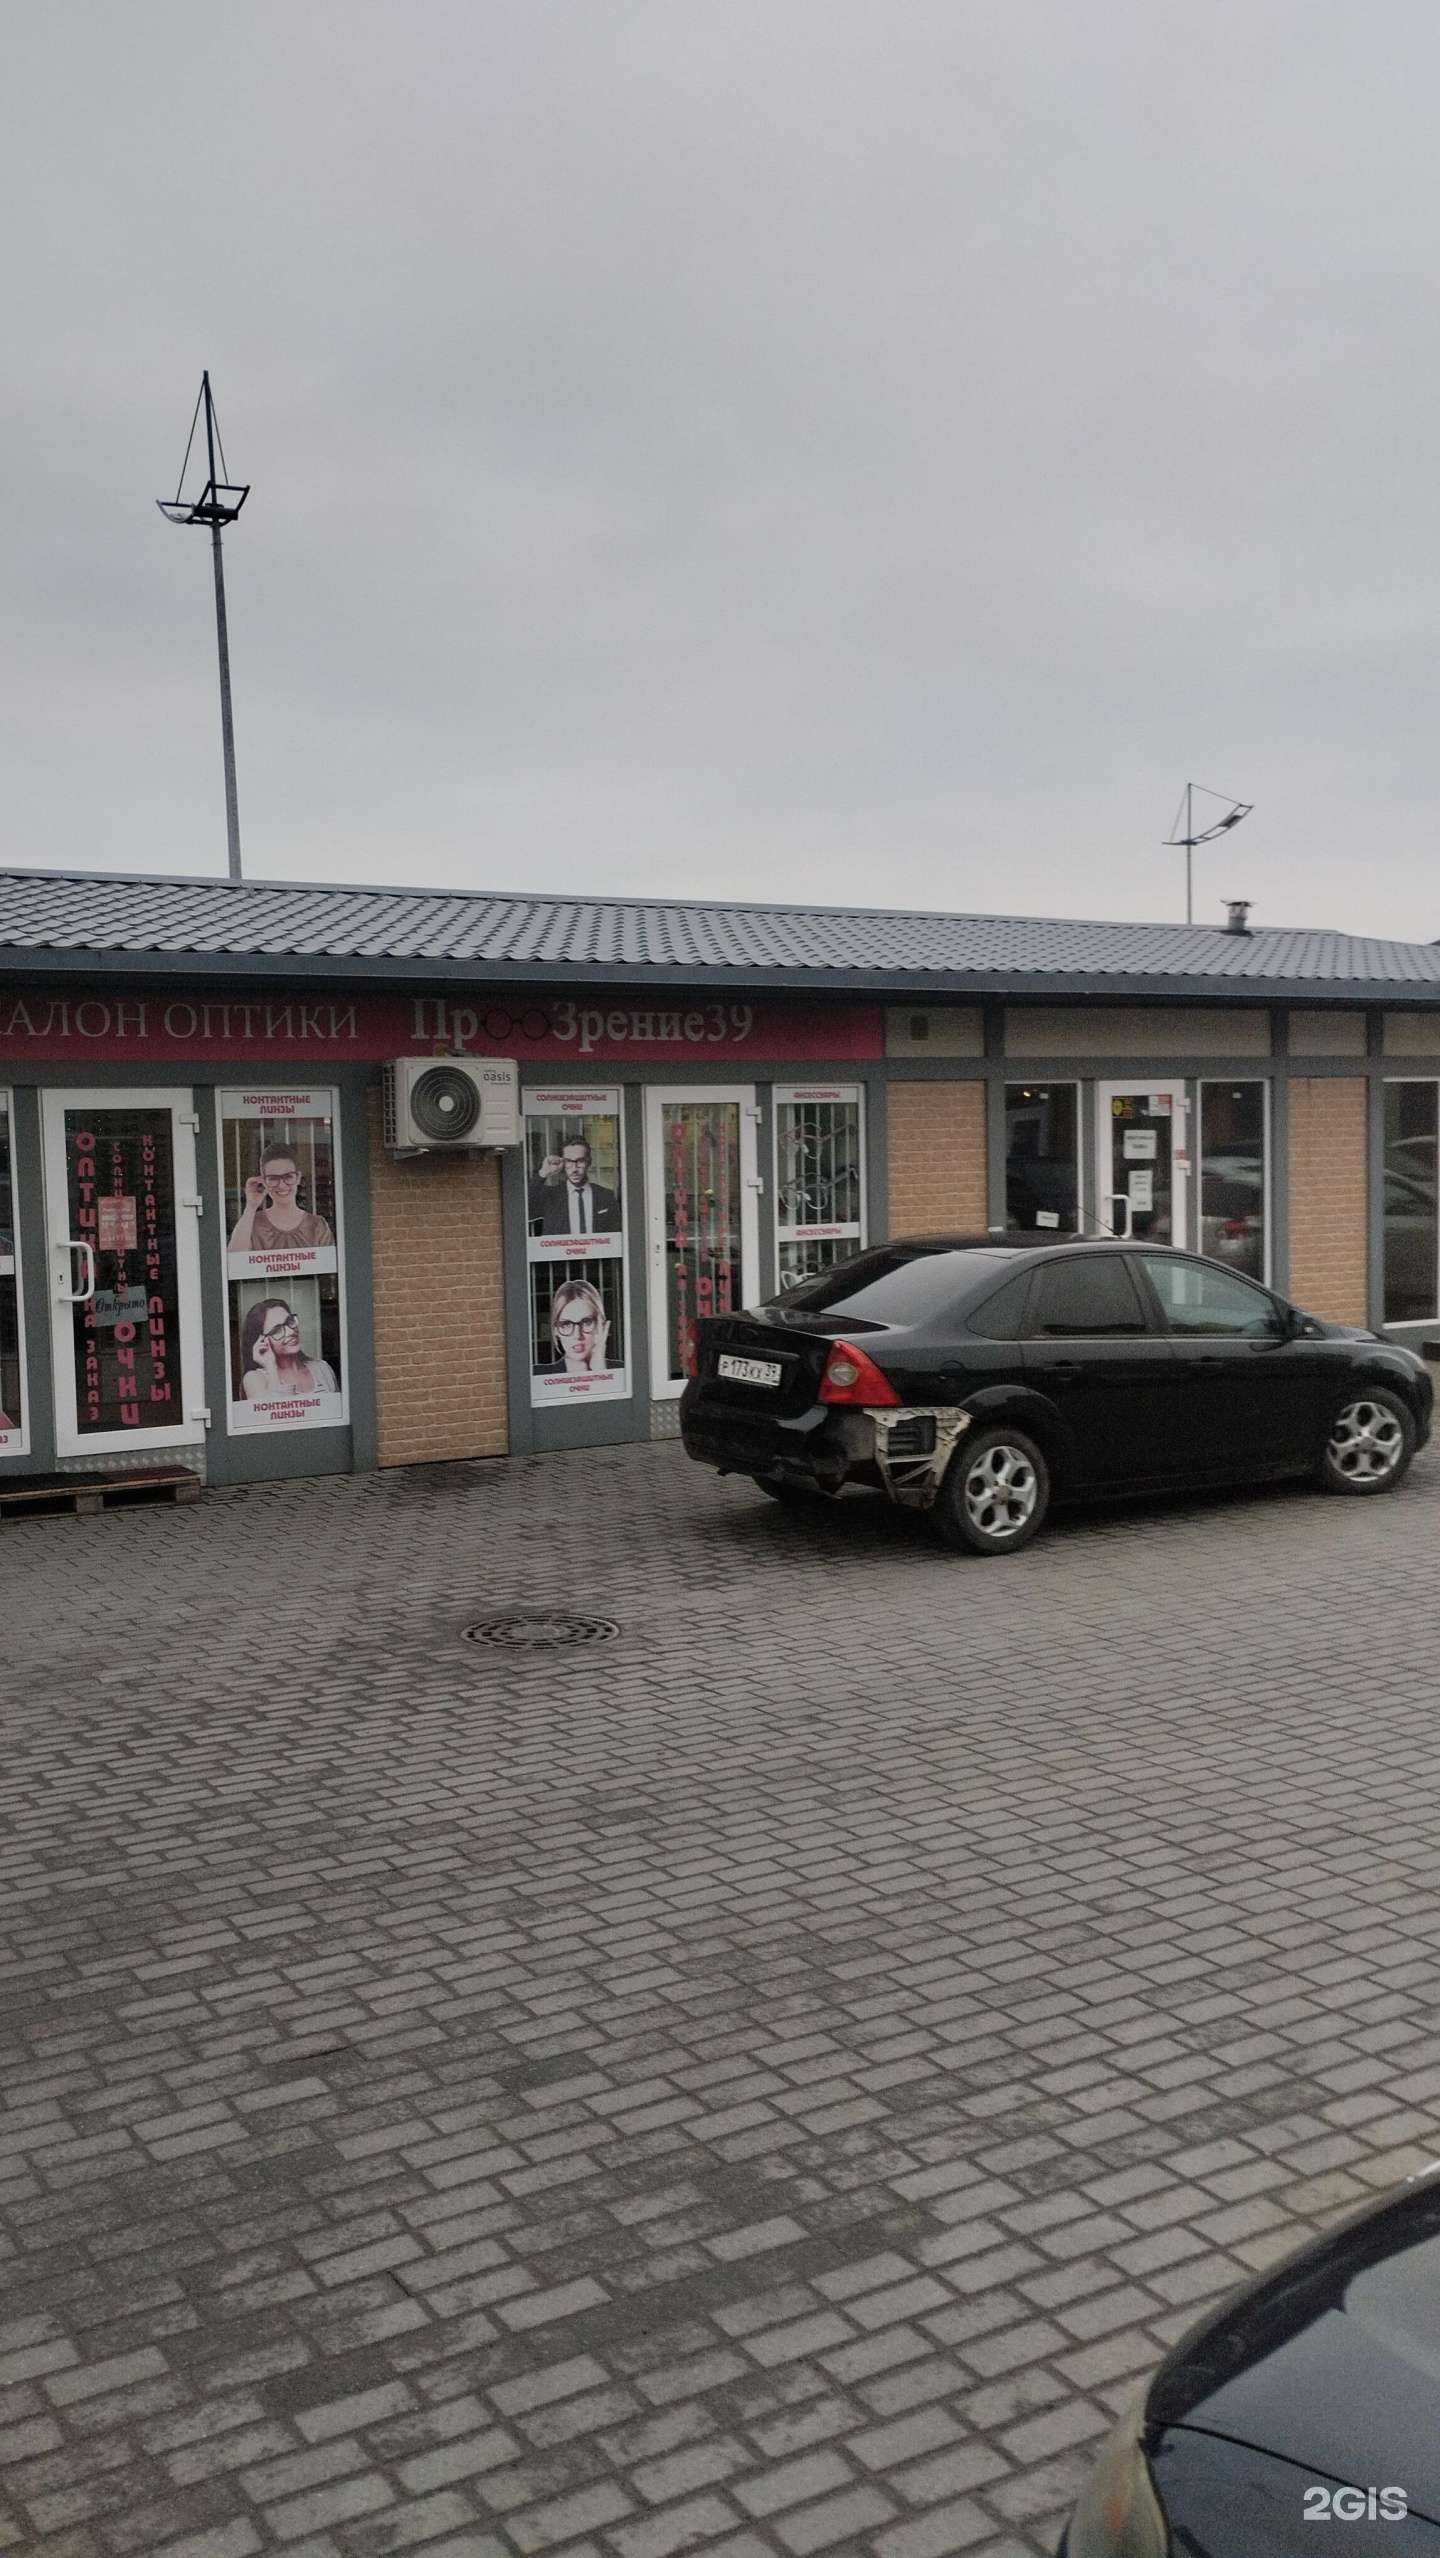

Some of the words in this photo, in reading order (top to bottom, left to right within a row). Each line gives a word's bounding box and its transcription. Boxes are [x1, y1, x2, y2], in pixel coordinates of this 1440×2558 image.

[0, 1001, 149, 1038] АЛОН
[164, 1003, 360, 1039] ОПТИКИ
[260, 1105, 296, 1114] ЛИНЗЫ
[266, 1263, 300, 1273] ЛИНЗЫ
[148, 1296, 172, 1401] ЛИНЗЫ
[86, 1340, 99, 1421] ЗАКАЗ
[114, 1321, 139, 1425] ОЧКИ
[270, 1410, 304, 1420] ЛИНЗЫ
